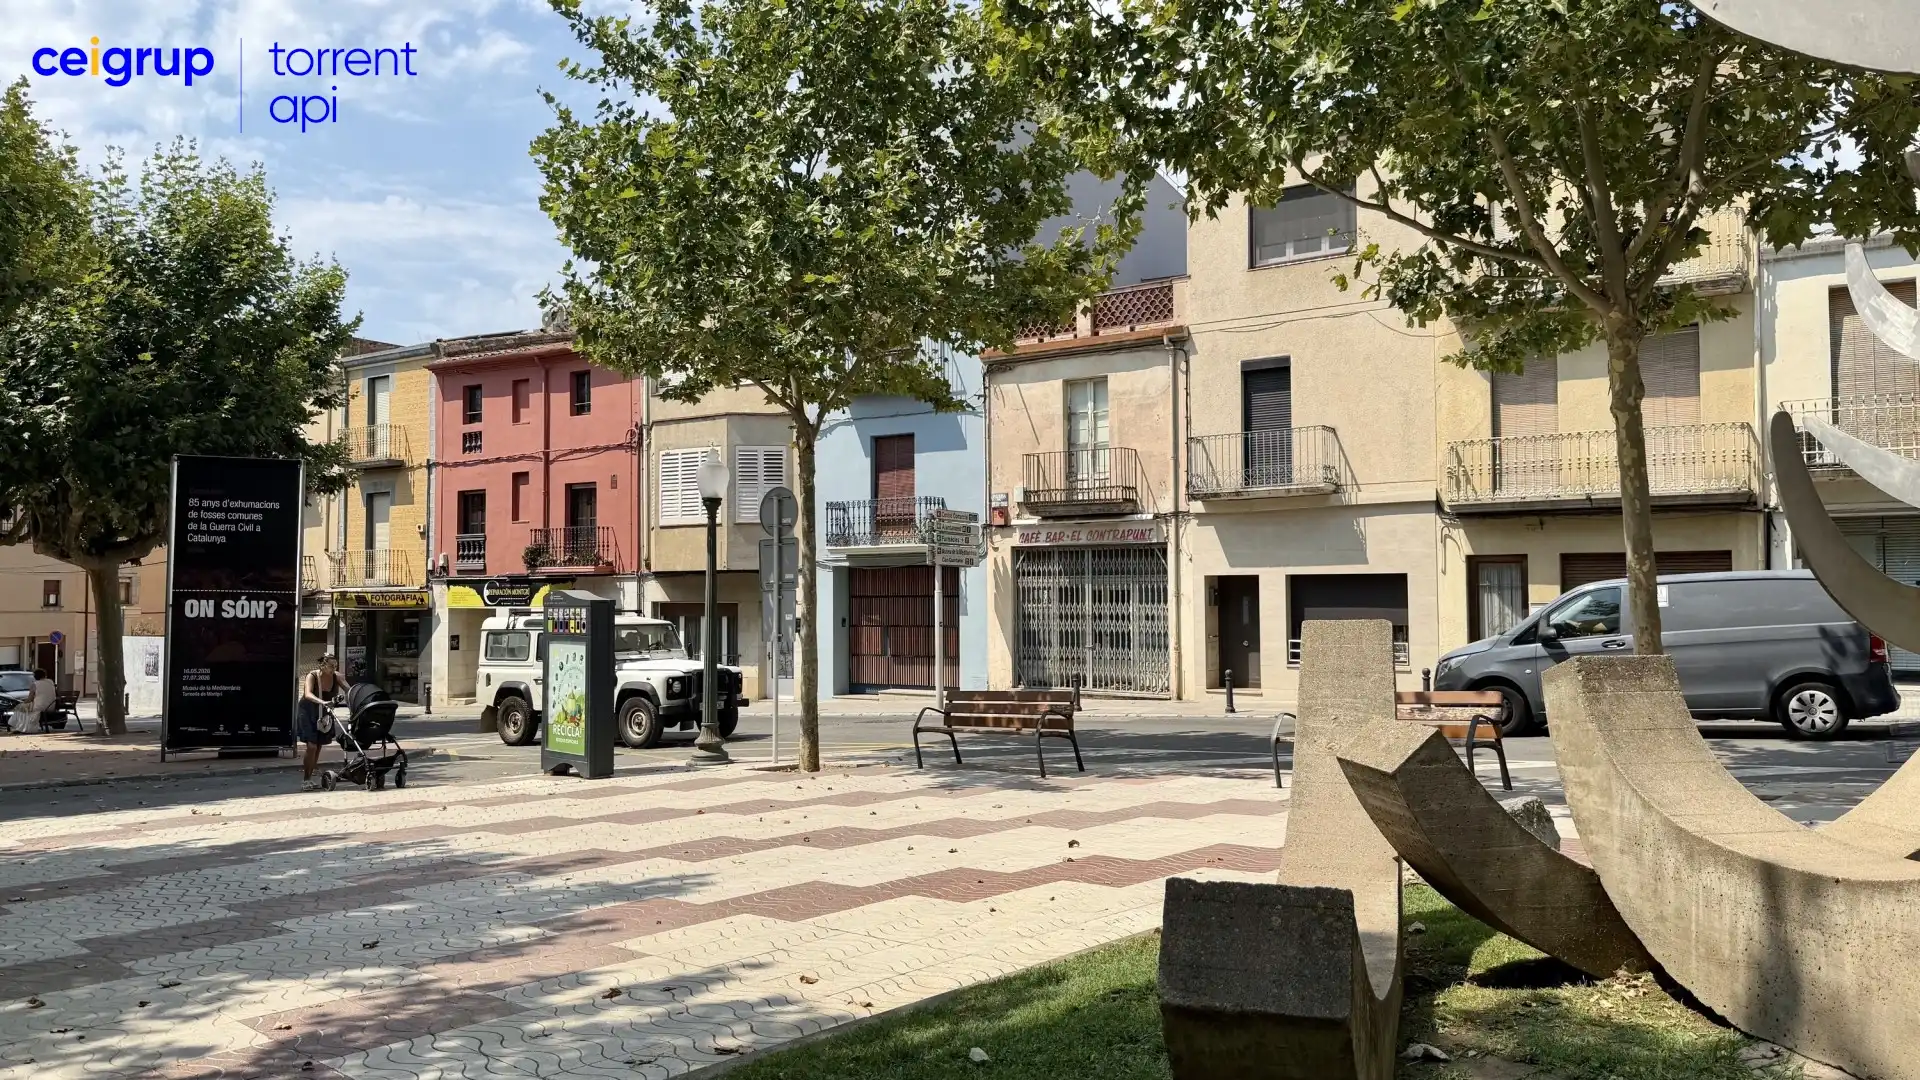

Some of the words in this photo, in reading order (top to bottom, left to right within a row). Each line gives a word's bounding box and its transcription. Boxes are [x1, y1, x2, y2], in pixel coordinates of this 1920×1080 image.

[188, 498, 200, 507] 85
[201, 500, 220, 509] anys
[222, 499, 280, 510] d'exhumacions
[187, 510, 199, 519] de
[200, 509, 226, 520] fosses
[227, 512, 263, 521] comunes
[187, 521, 198, 531] de
[199, 522, 207, 531] la
[209, 522, 236, 532] Guerra
[237, 523, 254, 532] Civil
[187, 533, 227, 544] Catalunya
[1045, 531, 1065, 543] BAR
[1070, 530, 1082, 541] EL
[1086, 528, 1154, 541] CONTRAPUNT
[370, 594, 417, 602] FOTOGRAFIA
[184, 599, 215, 618] ON
[221, 595, 278, 619] SÓN?
[552, 724, 582, 738] RECICLA!
